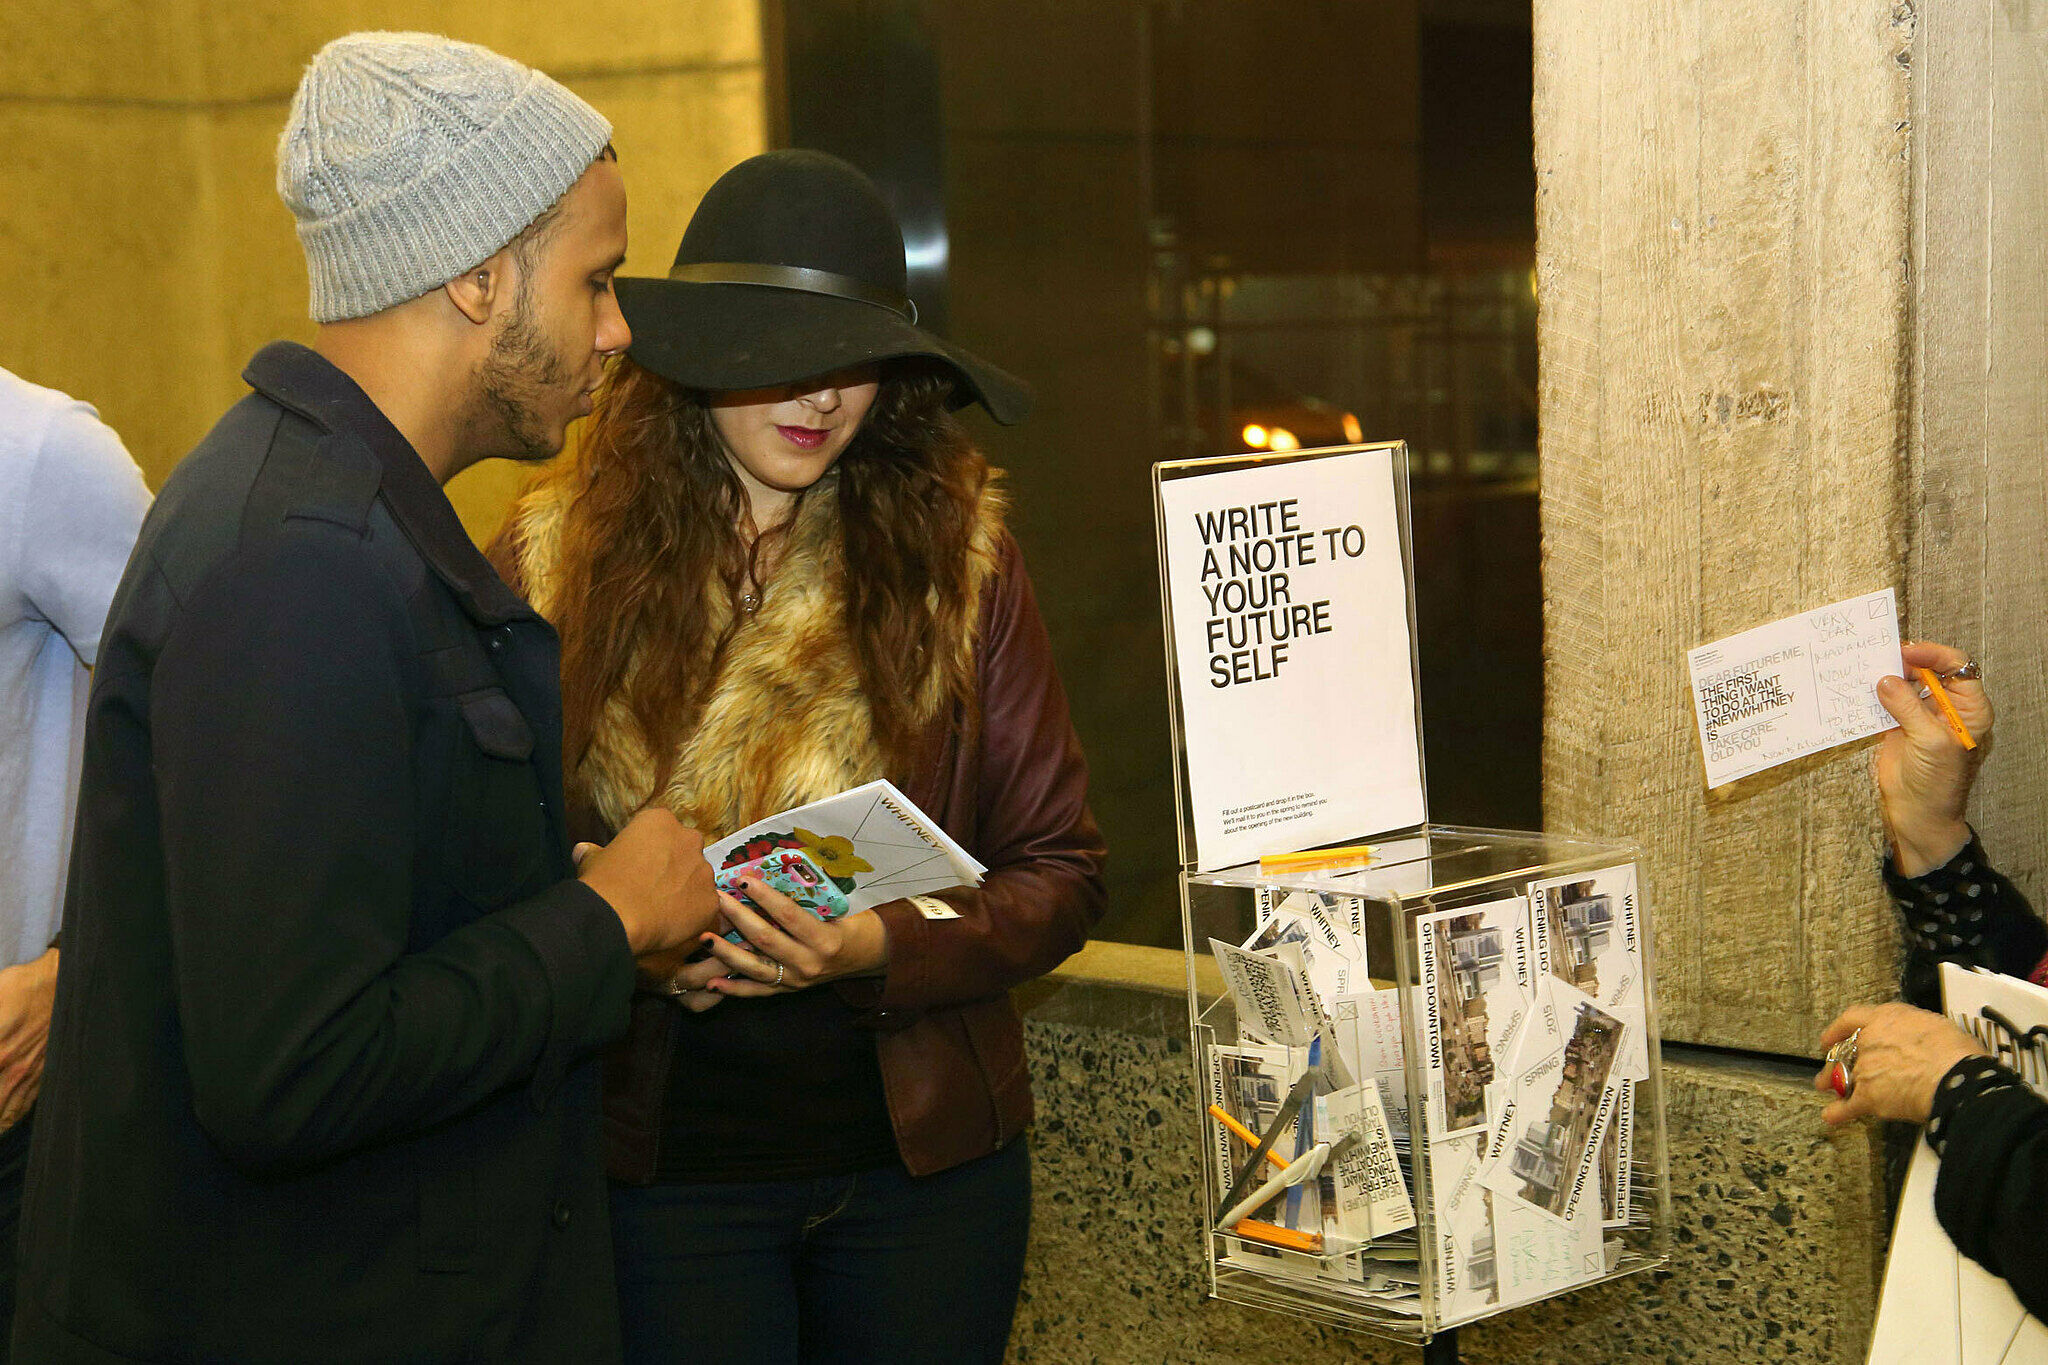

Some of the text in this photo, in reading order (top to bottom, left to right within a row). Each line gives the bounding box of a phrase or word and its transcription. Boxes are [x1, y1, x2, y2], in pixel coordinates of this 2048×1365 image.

[1195, 498, 1300, 545] WRITE
[1200, 524, 1366, 582] A NOTE TO
[1202, 572, 1290, 616] YOUR
[1206, 600, 1332, 653] FUTURE
[1210, 643, 1289, 688] SELF
[1699, 670, 1731, 689] DEAR
[1732, 654, 1780, 677] FUTURE
[1782, 646, 1804, 661] ME,
[1700, 670, 1759, 699] THE FIRST
[1702, 675, 1780, 710] THING I WANT
[1703, 685, 1783, 720] TO DO AT THE
[1706, 692, 1794, 731] #NEWWHITNEY
[1707, 730, 1718, 742] IS
[1709, 722, 1777, 751] TAKE CARE,
[1711, 737, 1761, 762] OLD YOU
[880, 797, 944, 850] WHITNEY
[1243, 802, 1265, 813] postcard
[1248, 820, 1268, 830] opening
[1280, 805, 1295, 814] spring
[1301, 800, 1318, 809] remind
[1311, 903, 1340, 949] WHITNEY
[1535, 889, 1549, 976] OPENING DO
[1624, 894, 1636, 953] WHITNEY
[1422, 922, 1436, 984] OPENING
[1516, 926, 1528, 988] WHITNEY
[1426, 986, 1440, 1069] DOWNTOWN
[1495, 1010, 1522, 1055] SPRING
[1543, 1004, 1557, 1035] 2015
[1525, 1056, 1560, 1086] SPRING
[1491, 1100, 1516, 1160] WHITNEY
[1620, 1078, 1631, 1158] DOWNTOWN
[1219, 1122, 1232, 1190] OWNTOWN
[1366, 1154, 1379, 1168] DO
[1369, 1162, 1396, 1178] THING
[1380, 1151, 1392, 1163] TO
[1565, 1086, 1615, 1221] OPENING DOWNTOWN
[1380, 1173, 1399, 1189] THE
[1617, 1159, 1627, 1219] OPENING
[1444, 1234, 1453, 1294] WHITNEY
